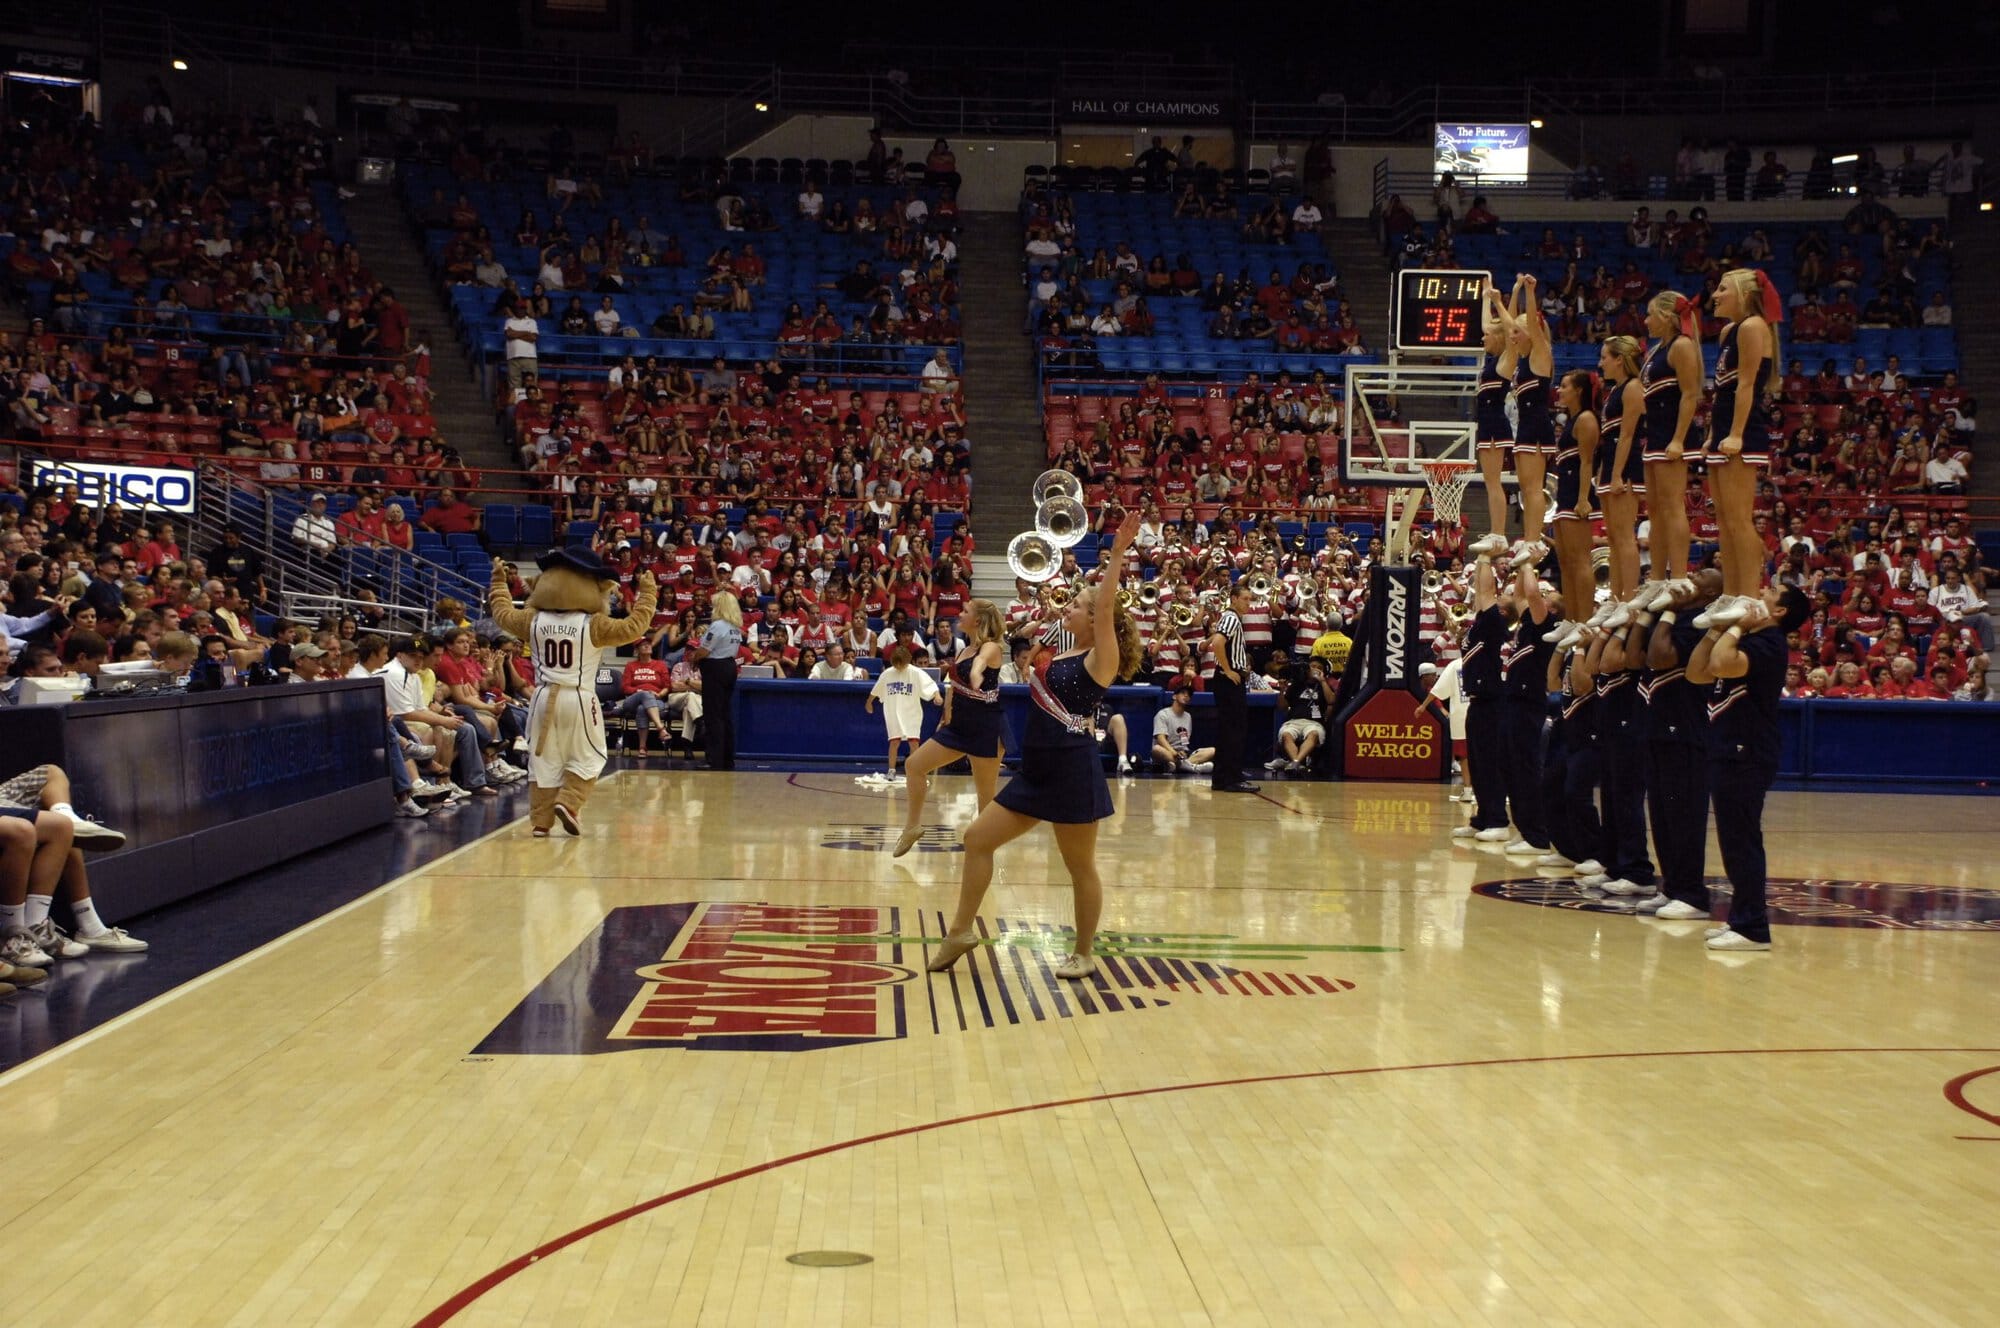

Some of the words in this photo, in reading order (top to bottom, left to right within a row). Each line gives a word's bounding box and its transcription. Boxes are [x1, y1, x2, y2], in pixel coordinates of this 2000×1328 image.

[1072, 101, 1107, 113] HALL
[1113, 101, 1130, 113] OF
[1136, 102, 1220, 115] CHAMPIONS
[1456, 126, 1473, 137] The
[1475, 126, 1508, 137] Future.
[1418, 278, 1480, 300] 10:14
[1420, 308, 1469, 341] 35
[165, 348, 179, 361] 19
[1209, 387, 1222, 398] 21
[310, 466, 324, 480] 19
[540, 624, 577, 638] WILBUR
[1385, 575, 1407, 682] ARIZONA
[544, 638, 573, 669] 00
[1067, 714, 1085, 734] A
[1354, 723, 1433, 739] WELLS
[1356, 742, 1432, 759] FARGO
[612, 903, 904, 1039] ARIZONA
